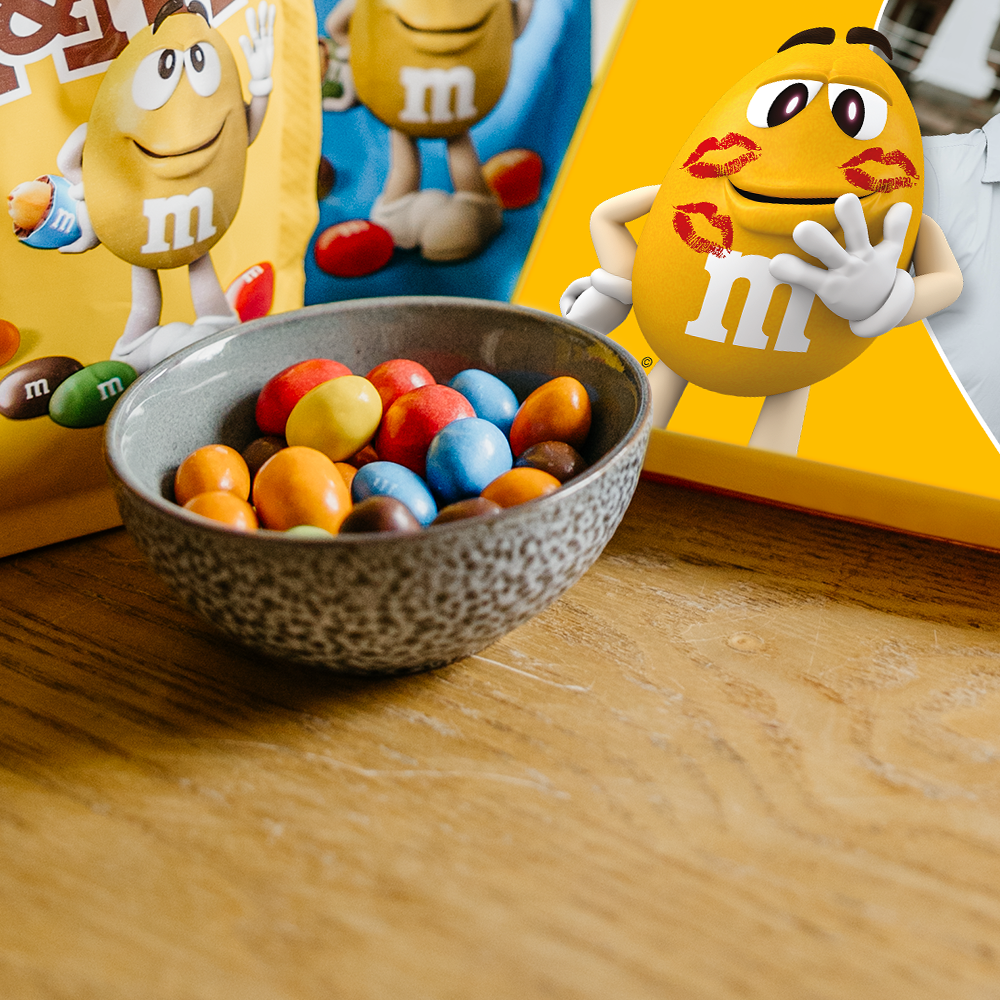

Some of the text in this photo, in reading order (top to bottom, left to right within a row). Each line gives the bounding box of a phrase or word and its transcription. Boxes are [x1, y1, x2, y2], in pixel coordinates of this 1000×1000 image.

[398, 65, 477, 124] m
[140, 186, 217, 254] m
[684, 249, 816, 353] m
[24, 378, 50, 400] m
[97, 376, 125, 401] m
